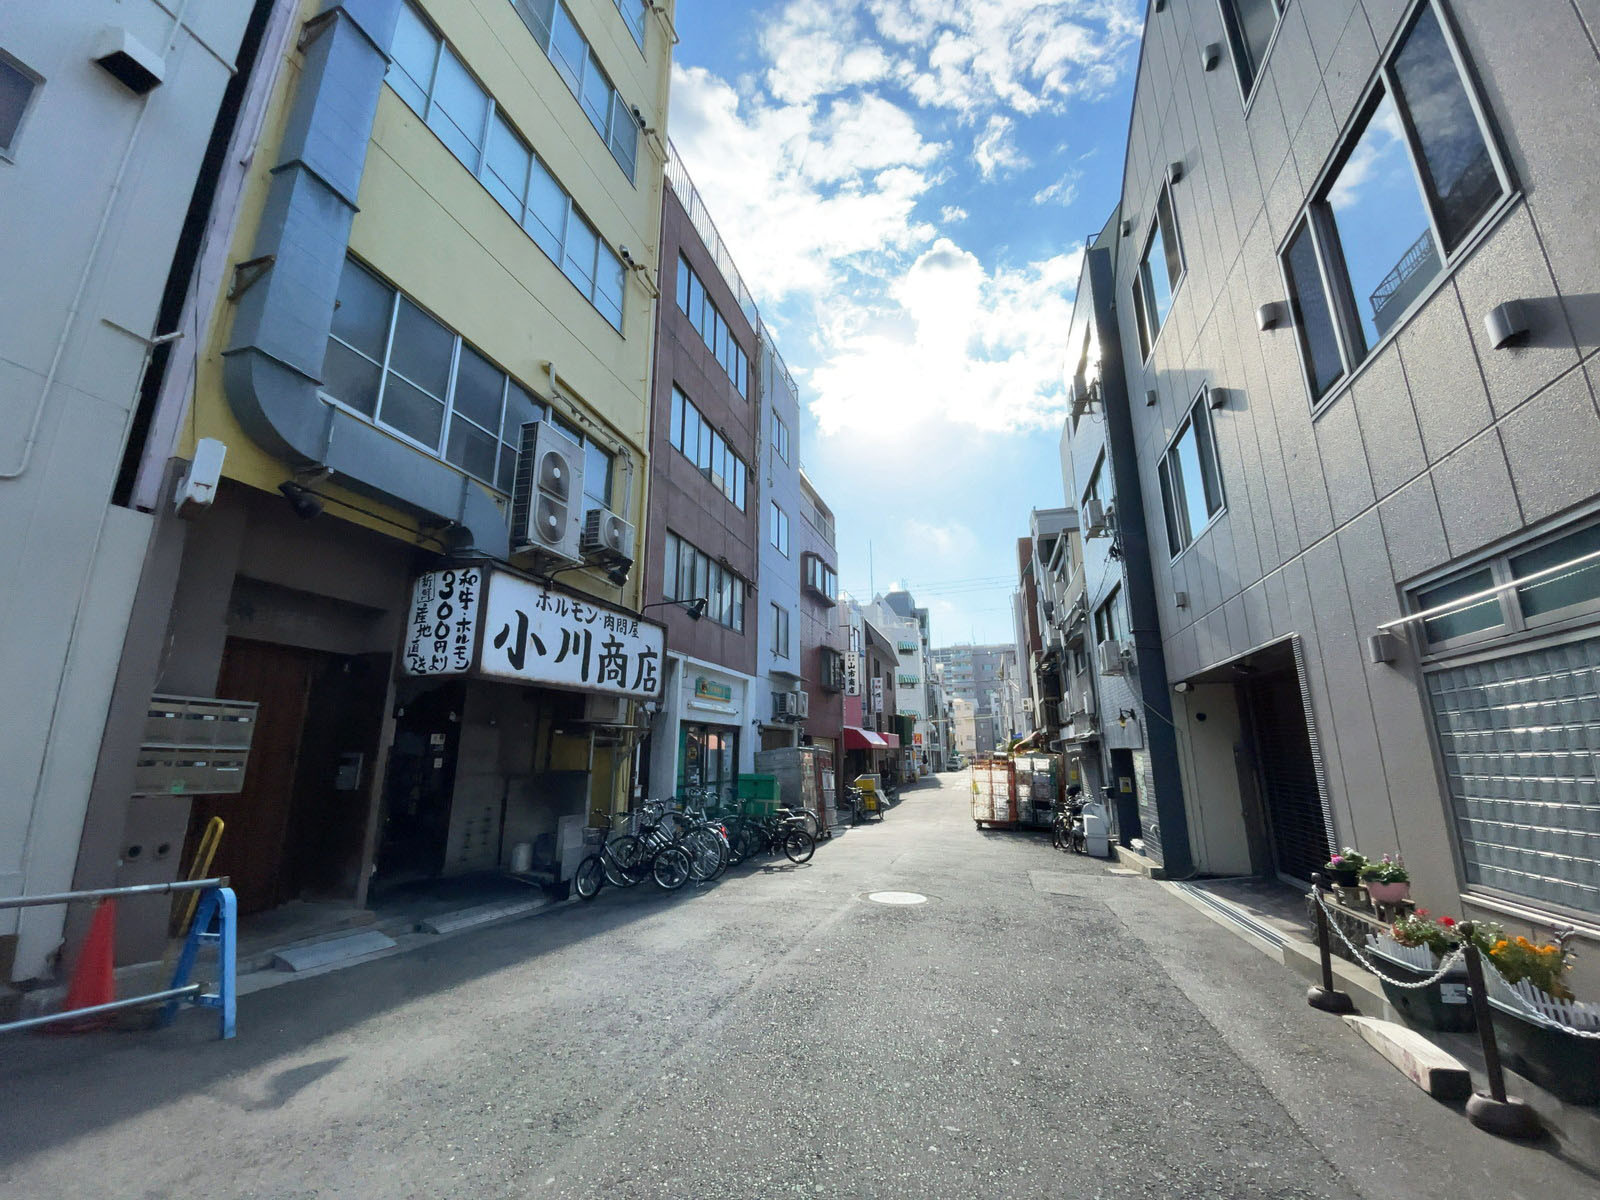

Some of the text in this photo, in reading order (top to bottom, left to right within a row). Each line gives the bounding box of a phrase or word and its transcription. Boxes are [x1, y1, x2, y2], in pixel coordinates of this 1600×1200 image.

[407, 603, 432, 674] 産地直送
[453, 569, 478, 670] 和牛・ホルモン
[494, 609, 658, 692] 小川商店
